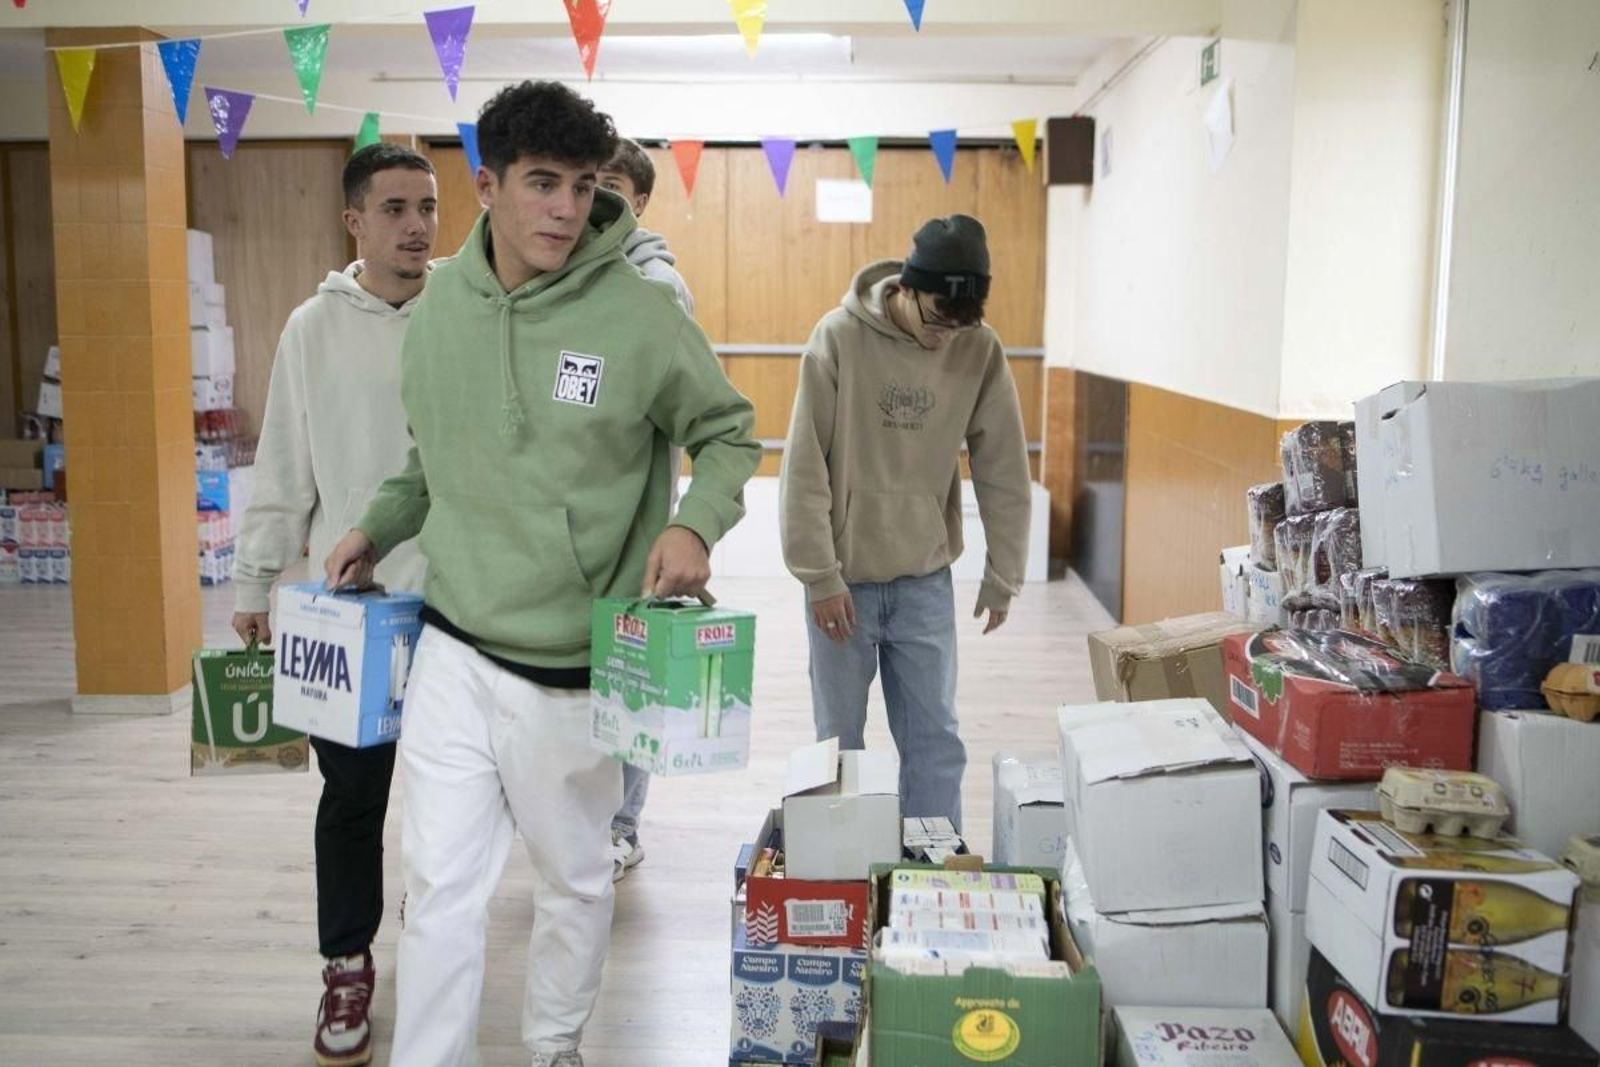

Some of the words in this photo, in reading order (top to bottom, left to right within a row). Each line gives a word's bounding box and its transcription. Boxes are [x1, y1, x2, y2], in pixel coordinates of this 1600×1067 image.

[557, 374, 596, 404] OBEY
[616, 615, 646, 639] FROIZ
[697, 626, 735, 642] FROIZ
[280, 632, 352, 693] LEYMA
[300, 685, 328, 702] NATURA
[740, 963, 779, 973] Nuestro
[794, 966, 833, 976] Nuestro
[1155, 1022, 1256, 1043] Pazo
[1177, 1042, 1249, 1052] Ribeiro
